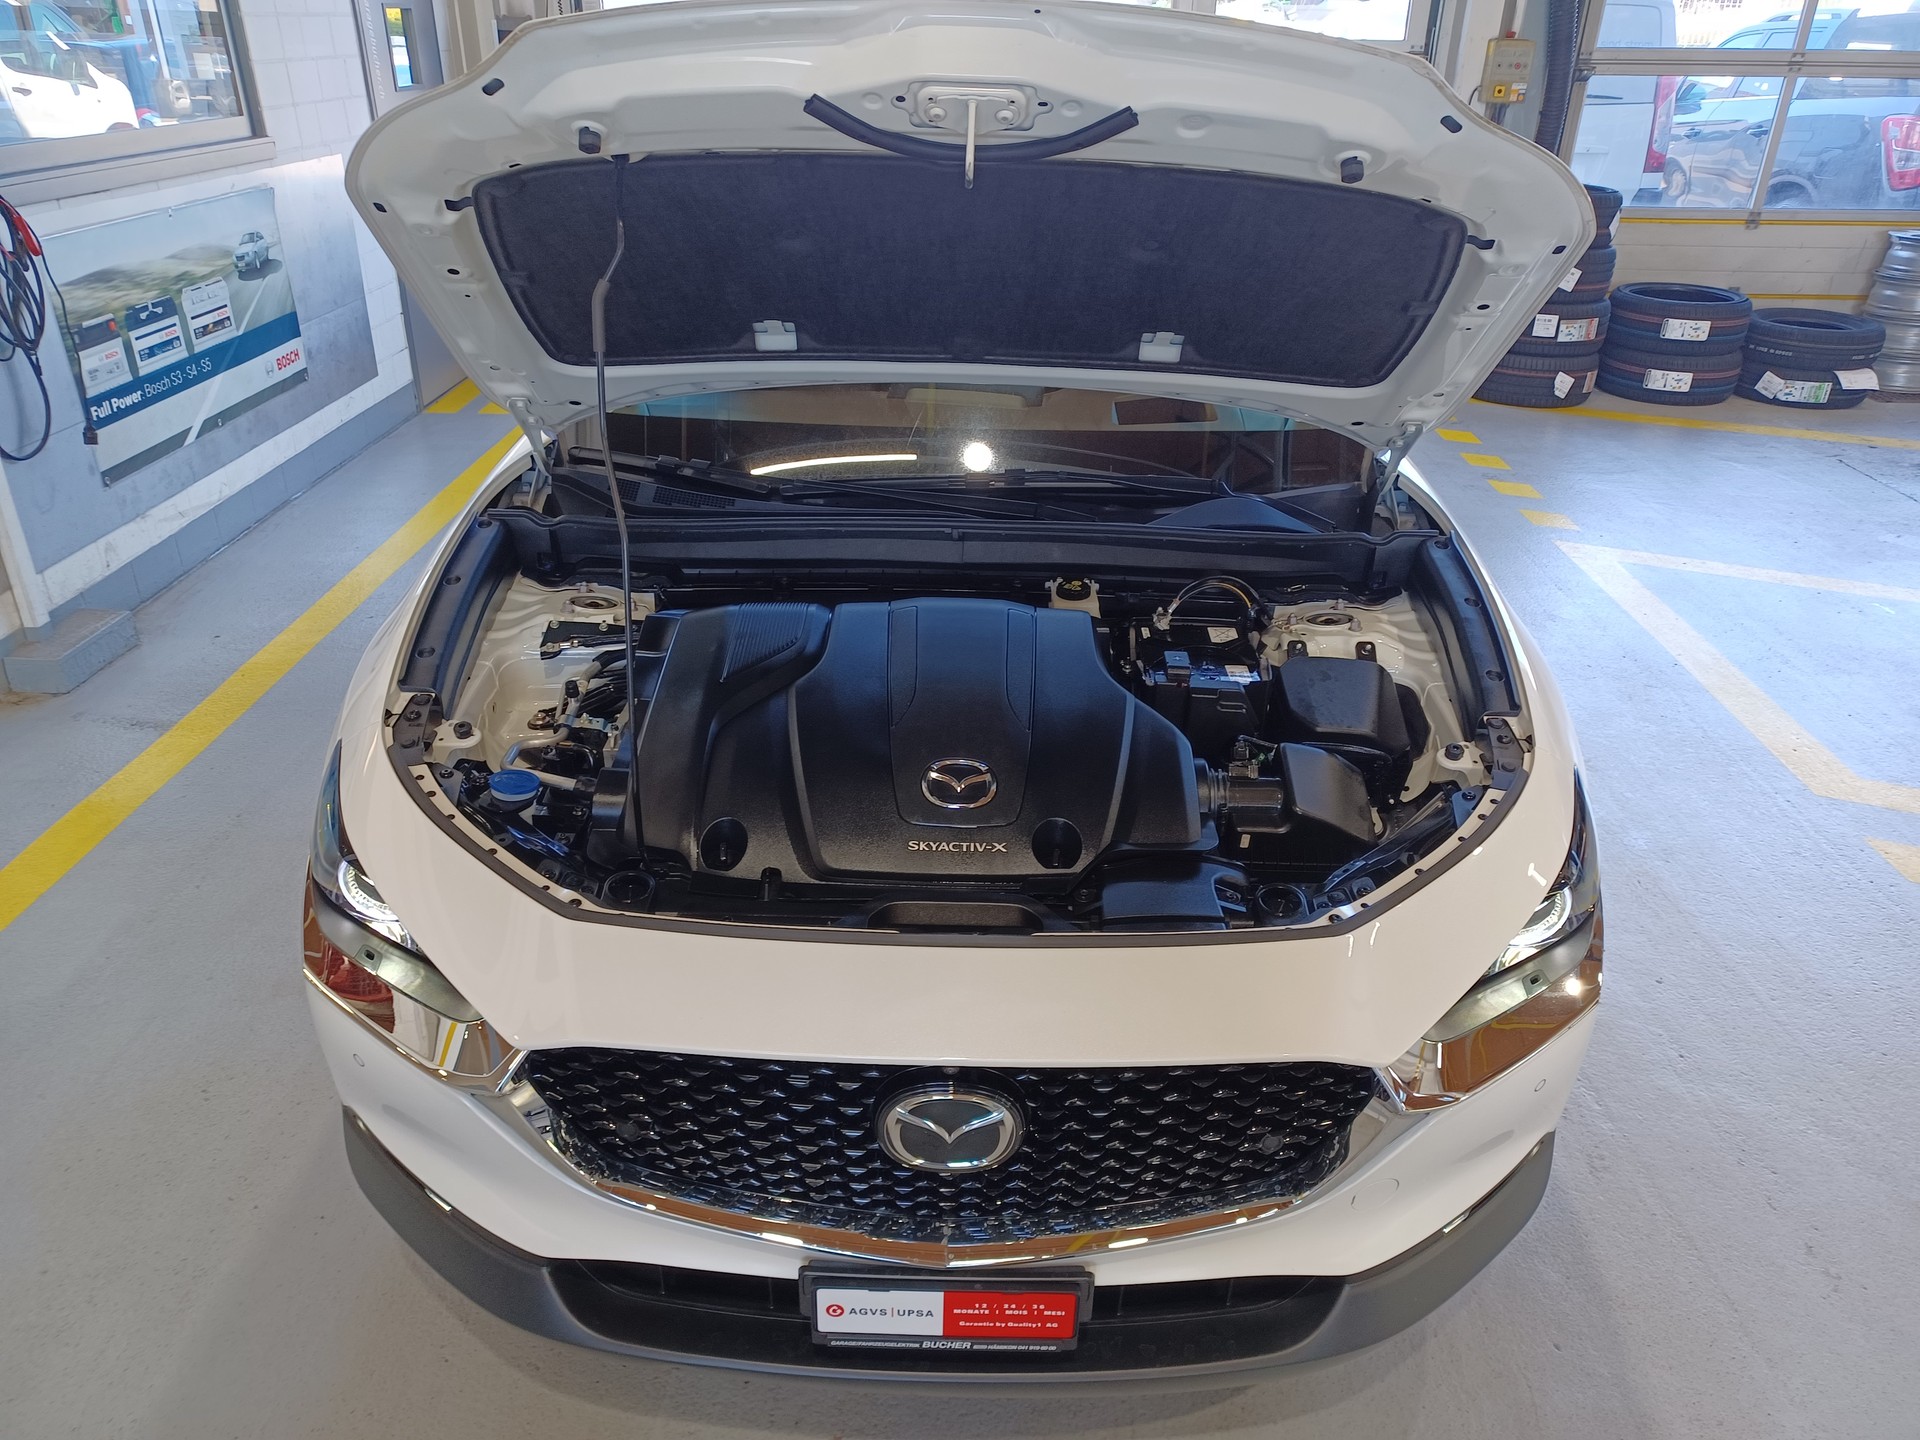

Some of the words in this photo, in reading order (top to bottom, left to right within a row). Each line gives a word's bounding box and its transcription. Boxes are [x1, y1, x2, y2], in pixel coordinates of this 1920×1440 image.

[276, 348, 300, 372] BOSCH
[90, 400, 112, 421] Full
[144, 376, 171, 398] Bosch
[171, 369, 183, 387] S3
[187, 363, 199, 380] S4
[200, 357, 212, 373] S5
[907, 840, 1008, 852] SKYACTIV-X
[849, 1308, 888, 1316] AGVS
[897, 1309, 934, 1317] UPSA
[922, 1341, 971, 1349] BUCHER
